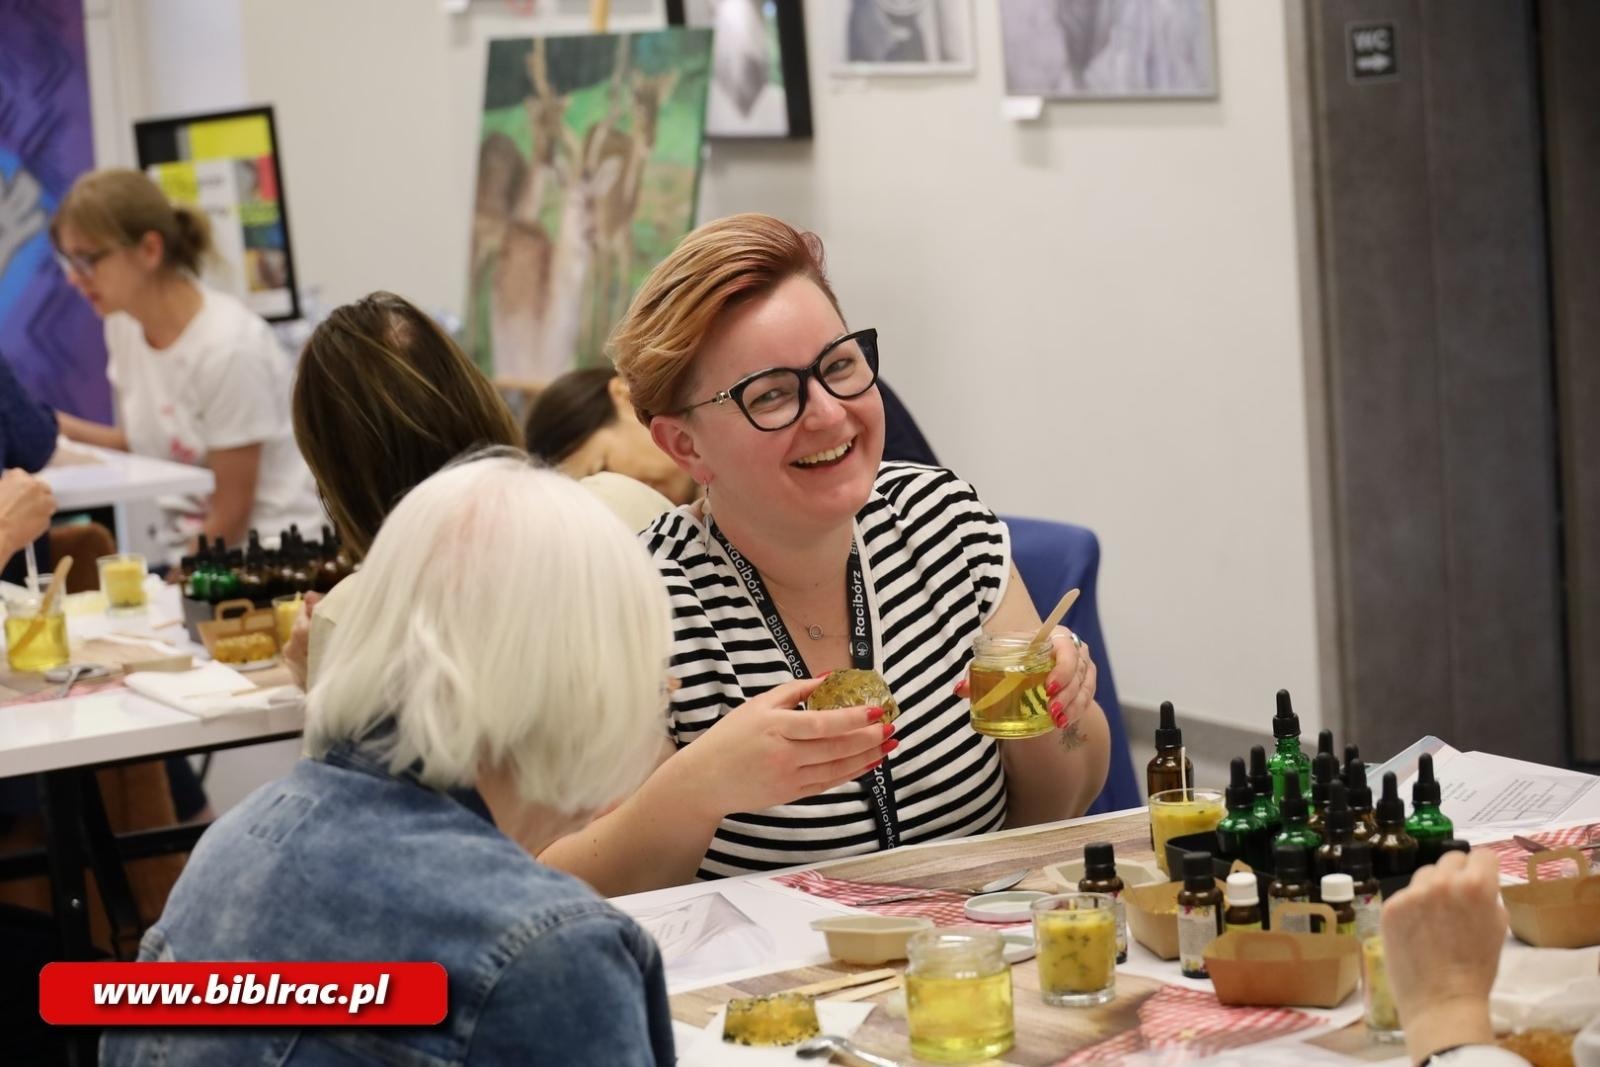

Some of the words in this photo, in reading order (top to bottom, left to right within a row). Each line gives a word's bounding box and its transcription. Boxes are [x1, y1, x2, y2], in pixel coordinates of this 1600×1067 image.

[1354, 29, 1391, 51] WC
[724, 543, 765, 604] Racibórz
[766, 614, 804, 679] Biblioteka
[852, 569, 866, 637] Racibórz
